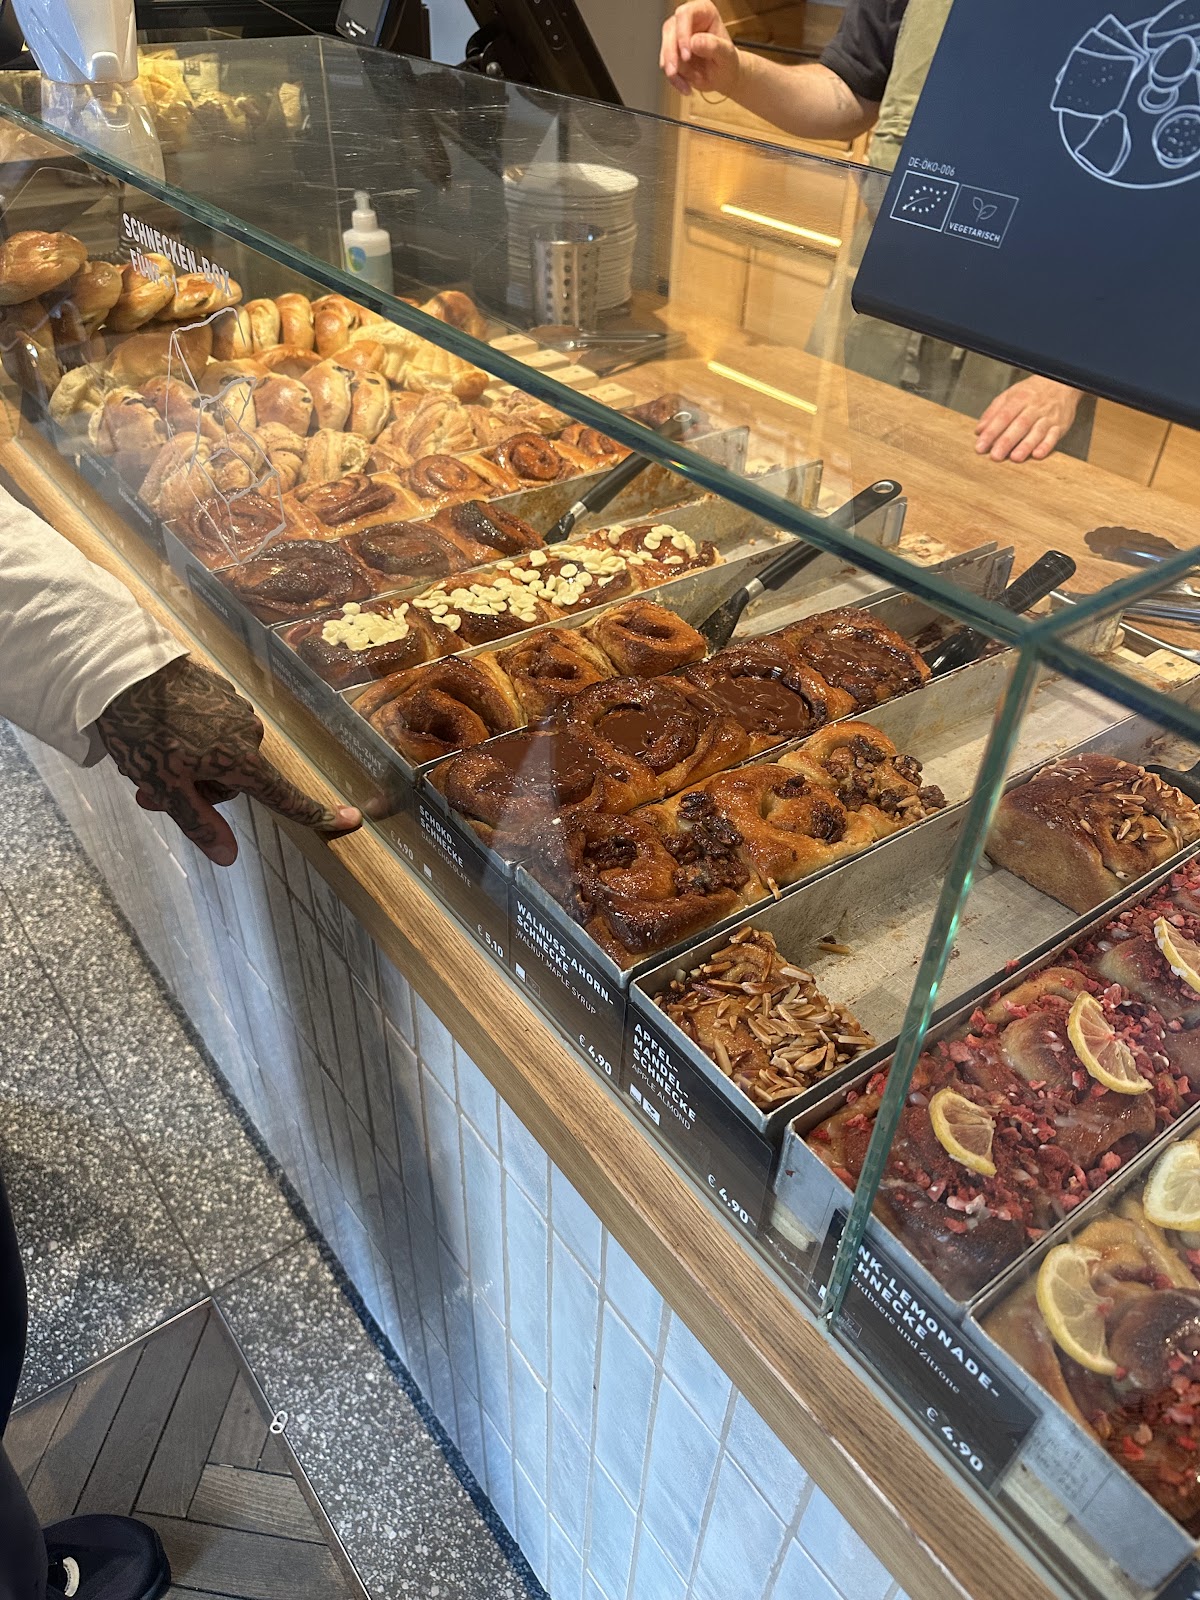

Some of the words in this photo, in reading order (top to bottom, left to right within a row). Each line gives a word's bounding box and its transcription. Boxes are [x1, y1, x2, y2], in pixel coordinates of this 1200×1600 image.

[908, 156, 956, 177] DE-ÖKO-006
[122, 212, 232, 298] SCHNECKEN-BOX
[949, 221, 1001, 243] VEGETARISCH
[340, 735, 378, 778] SCHNECKE
[419, 804, 456, 847] SCHOKO-
[420, 817, 464, 868] SCHNECKE
[421, 830, 437, 852] DARK
[438, 848, 471, 888] CHOCOLATE
[477, 923, 483, 936] €
[516, 914, 569, 975] SCHNECKE
[516, 900, 614, 1005] WALNUSS-AHORN-
[545, 961, 570, 990] MAPLE
[571, 986, 597, 1014] SYRUP
[579, 1034, 586, 1048] €
[633, 1034, 690, 1098] MANDEL-
[634, 1023, 679, 1073] APFEL-
[631, 1062, 656, 1093] APPLE
[656, 1089, 691, 1131] ALMOND
[633, 1047, 697, 1123] SCHNECKE
[707, 1173, 716, 1189] €
[842, 1248, 929, 1341] HNECKE
[842, 1226, 999, 1398] NK-LEMONADE-
[850, 1273, 896, 1326] Erdbeere
[897, 1323, 919, 1350] und
[919, 1347, 960, 1395] Zitrone
[926, 1405, 938, 1422] €
